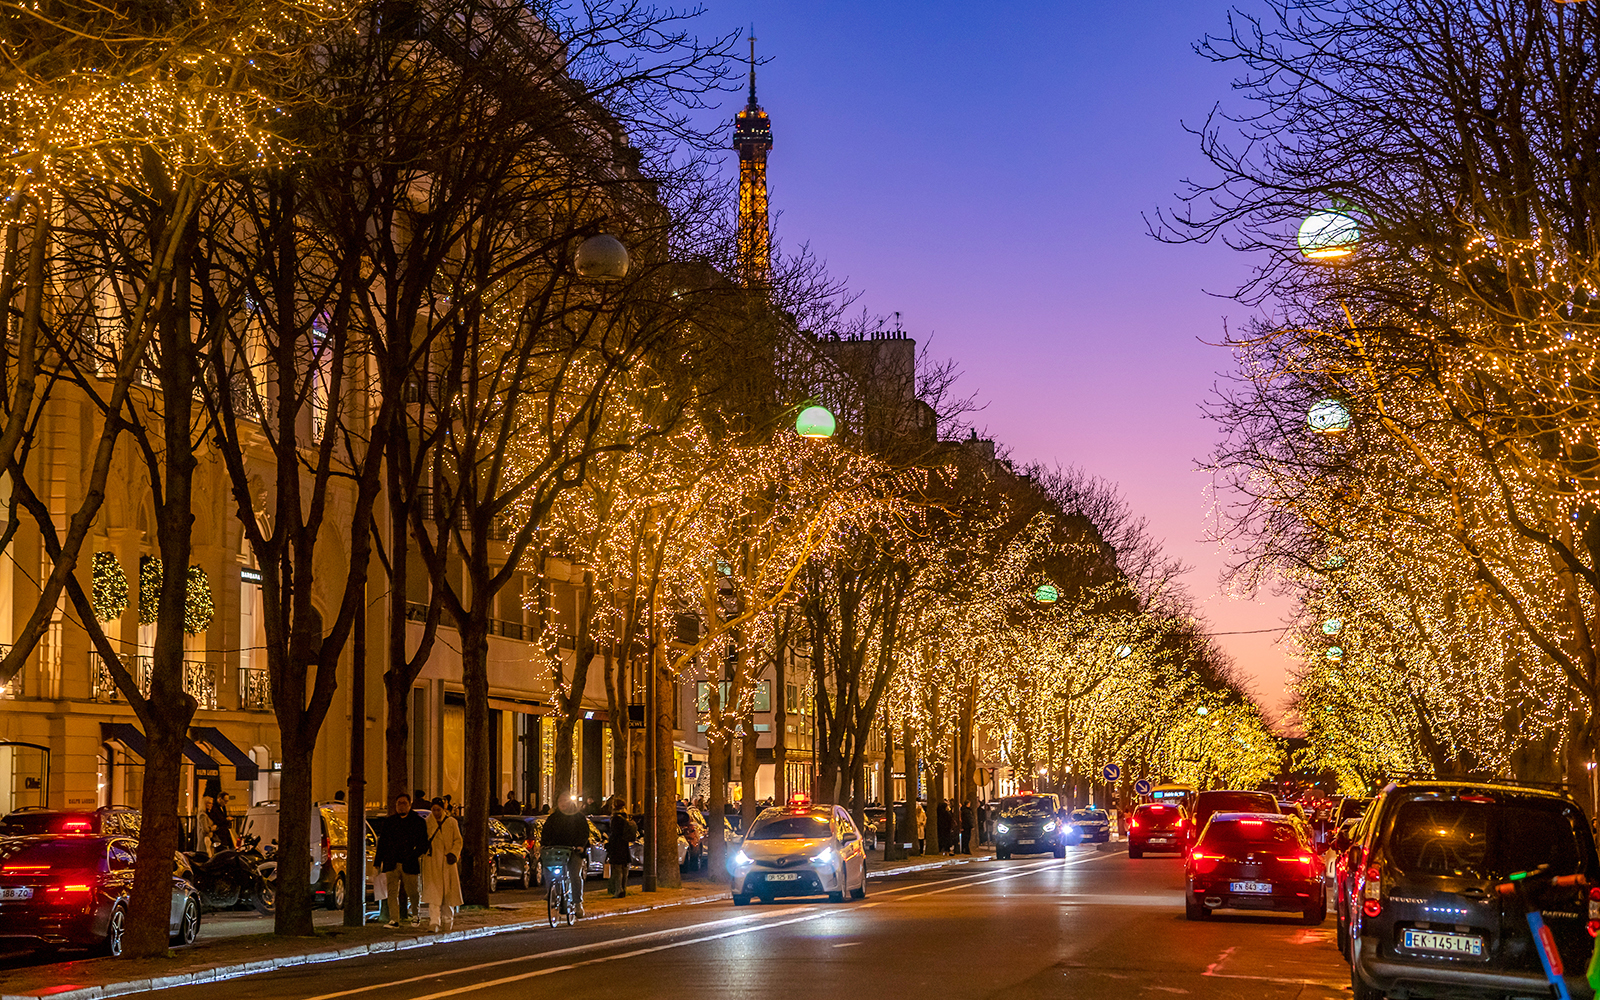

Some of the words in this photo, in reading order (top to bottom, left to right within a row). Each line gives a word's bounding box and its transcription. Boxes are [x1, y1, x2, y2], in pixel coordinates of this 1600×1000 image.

[241, 571, 260, 580] BARBARA
[687, 768, 694, 776] P
[1389, 896, 1428, 905] PEUGEOT
[1542, 909, 1579, 919] PARTNER
